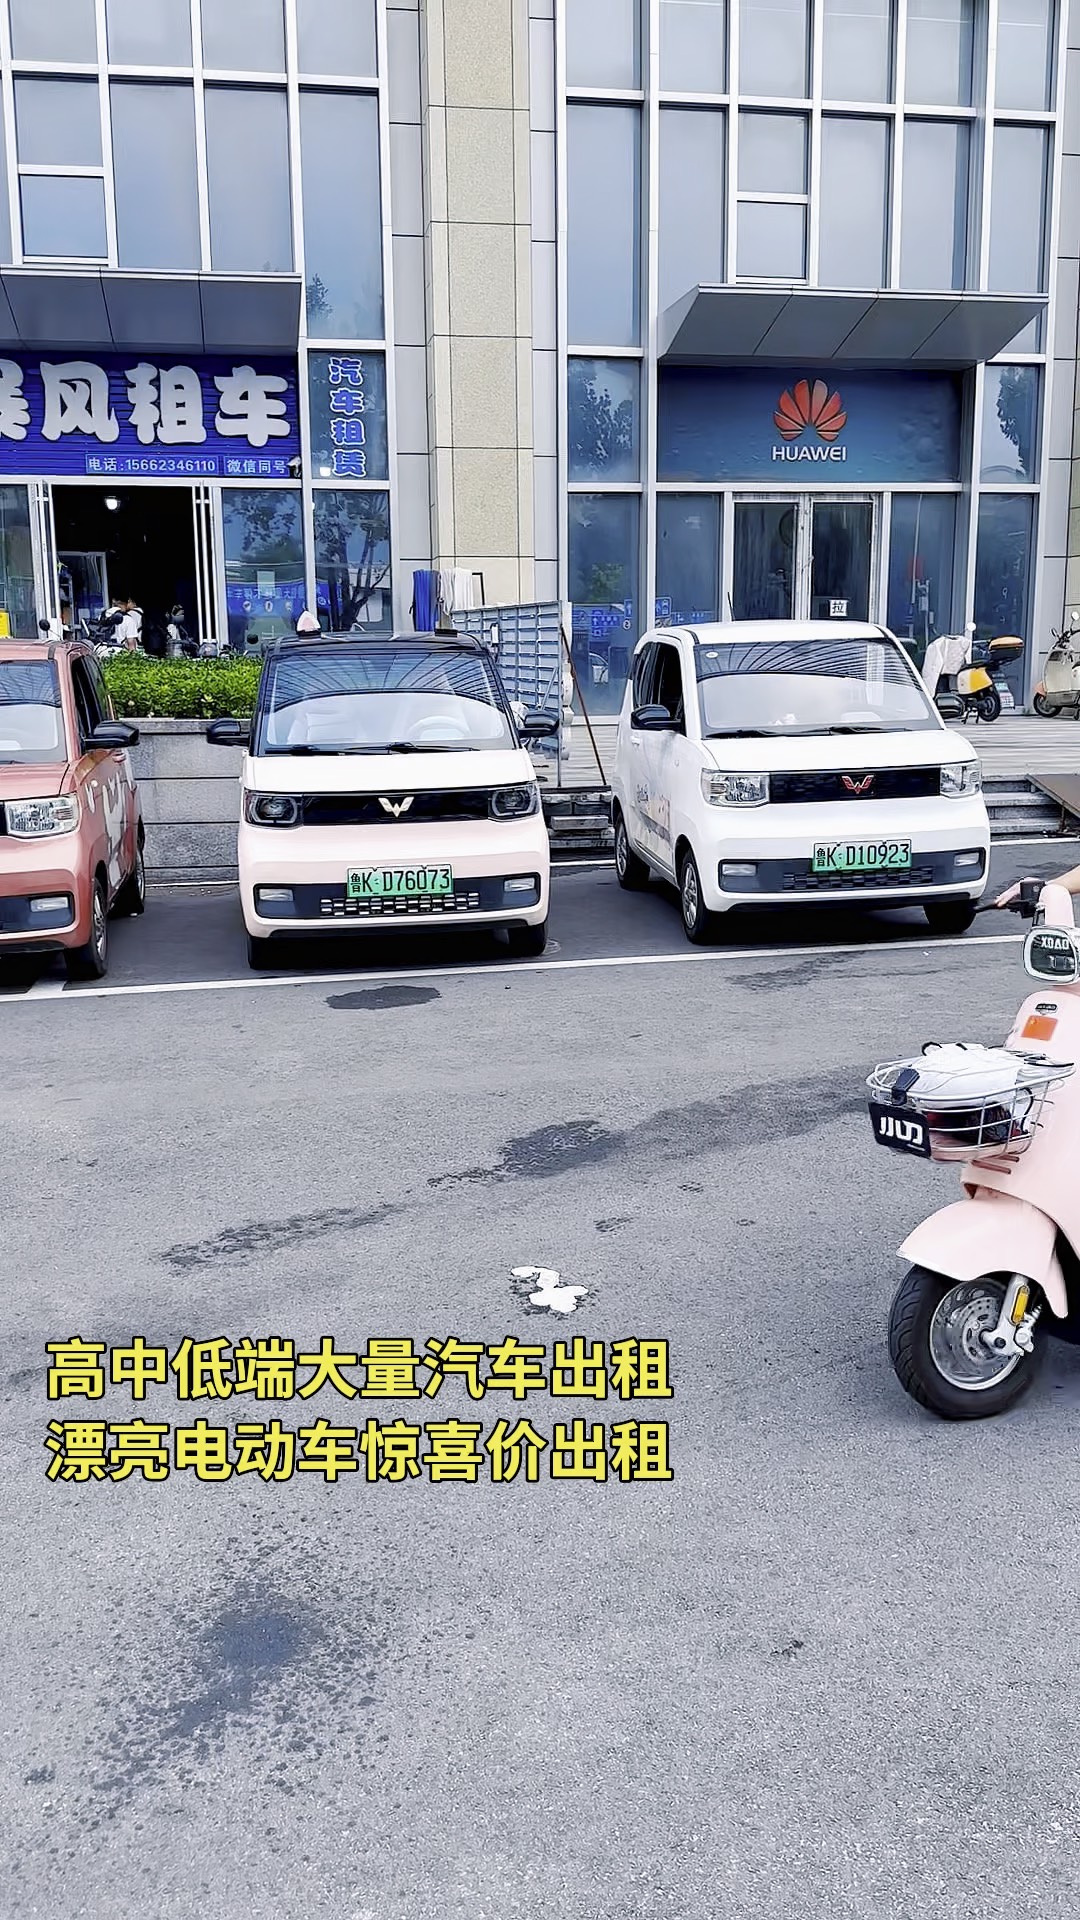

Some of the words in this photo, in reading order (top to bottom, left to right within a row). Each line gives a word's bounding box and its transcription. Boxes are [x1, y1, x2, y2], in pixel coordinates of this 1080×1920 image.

[329, 357, 366, 477] 汽车租赁
[772, 446, 847, 461] HUAWEI
[227, 459, 287, 474] 微信同号
